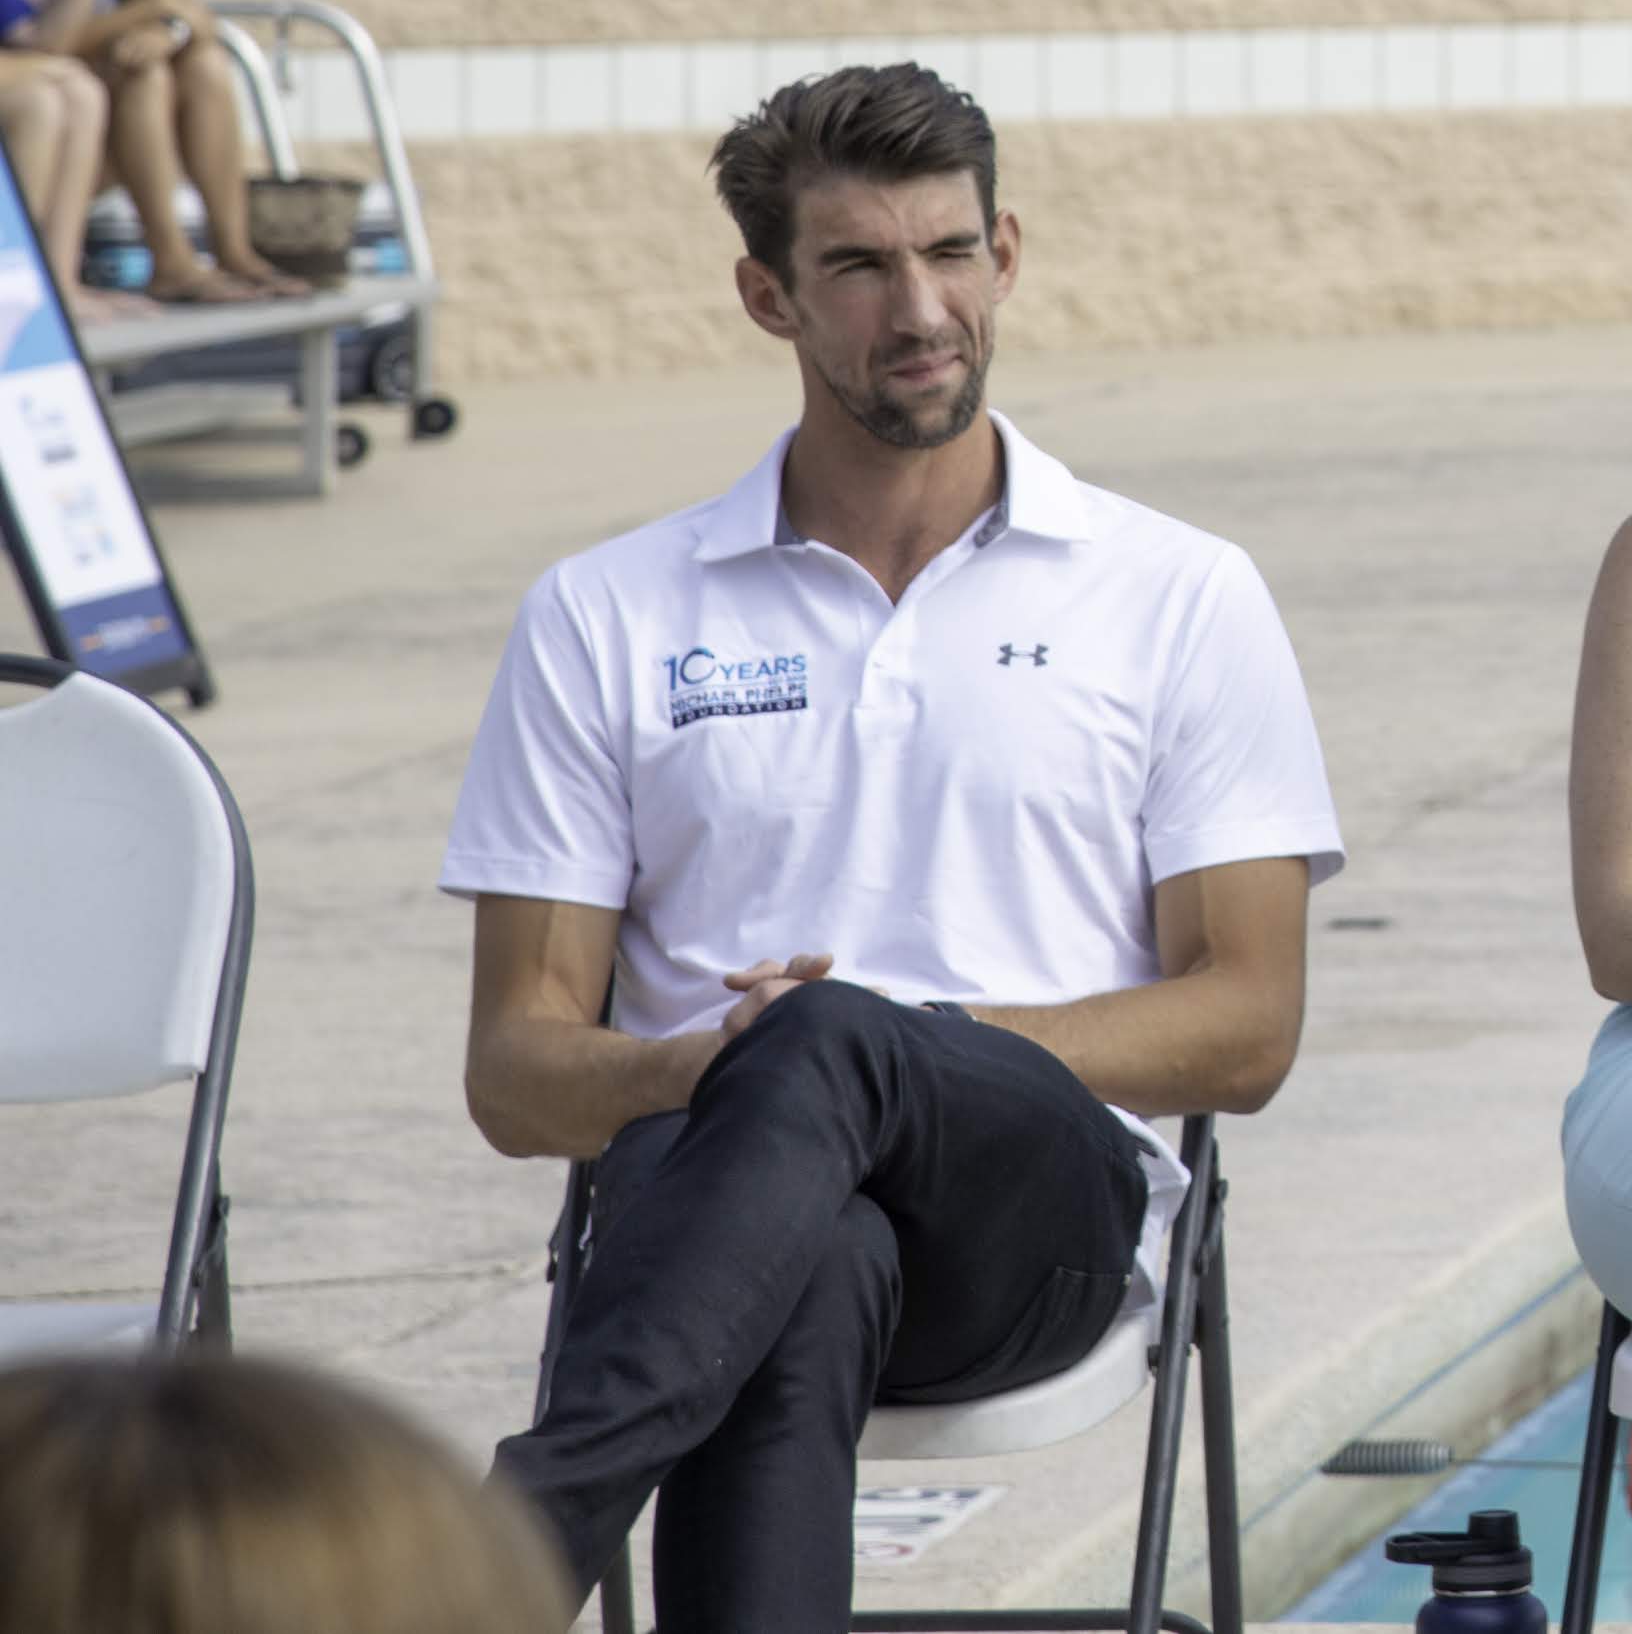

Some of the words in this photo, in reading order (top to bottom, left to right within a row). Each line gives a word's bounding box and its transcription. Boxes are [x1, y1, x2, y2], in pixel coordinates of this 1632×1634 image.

[663, 647, 716, 691] 10
[718, 654, 806, 680] YEARS
[671, 688, 737, 713] MICHAEL
[745, 681, 807, 703] PHELPS
[673, 698, 806, 727] FOUNDATION
